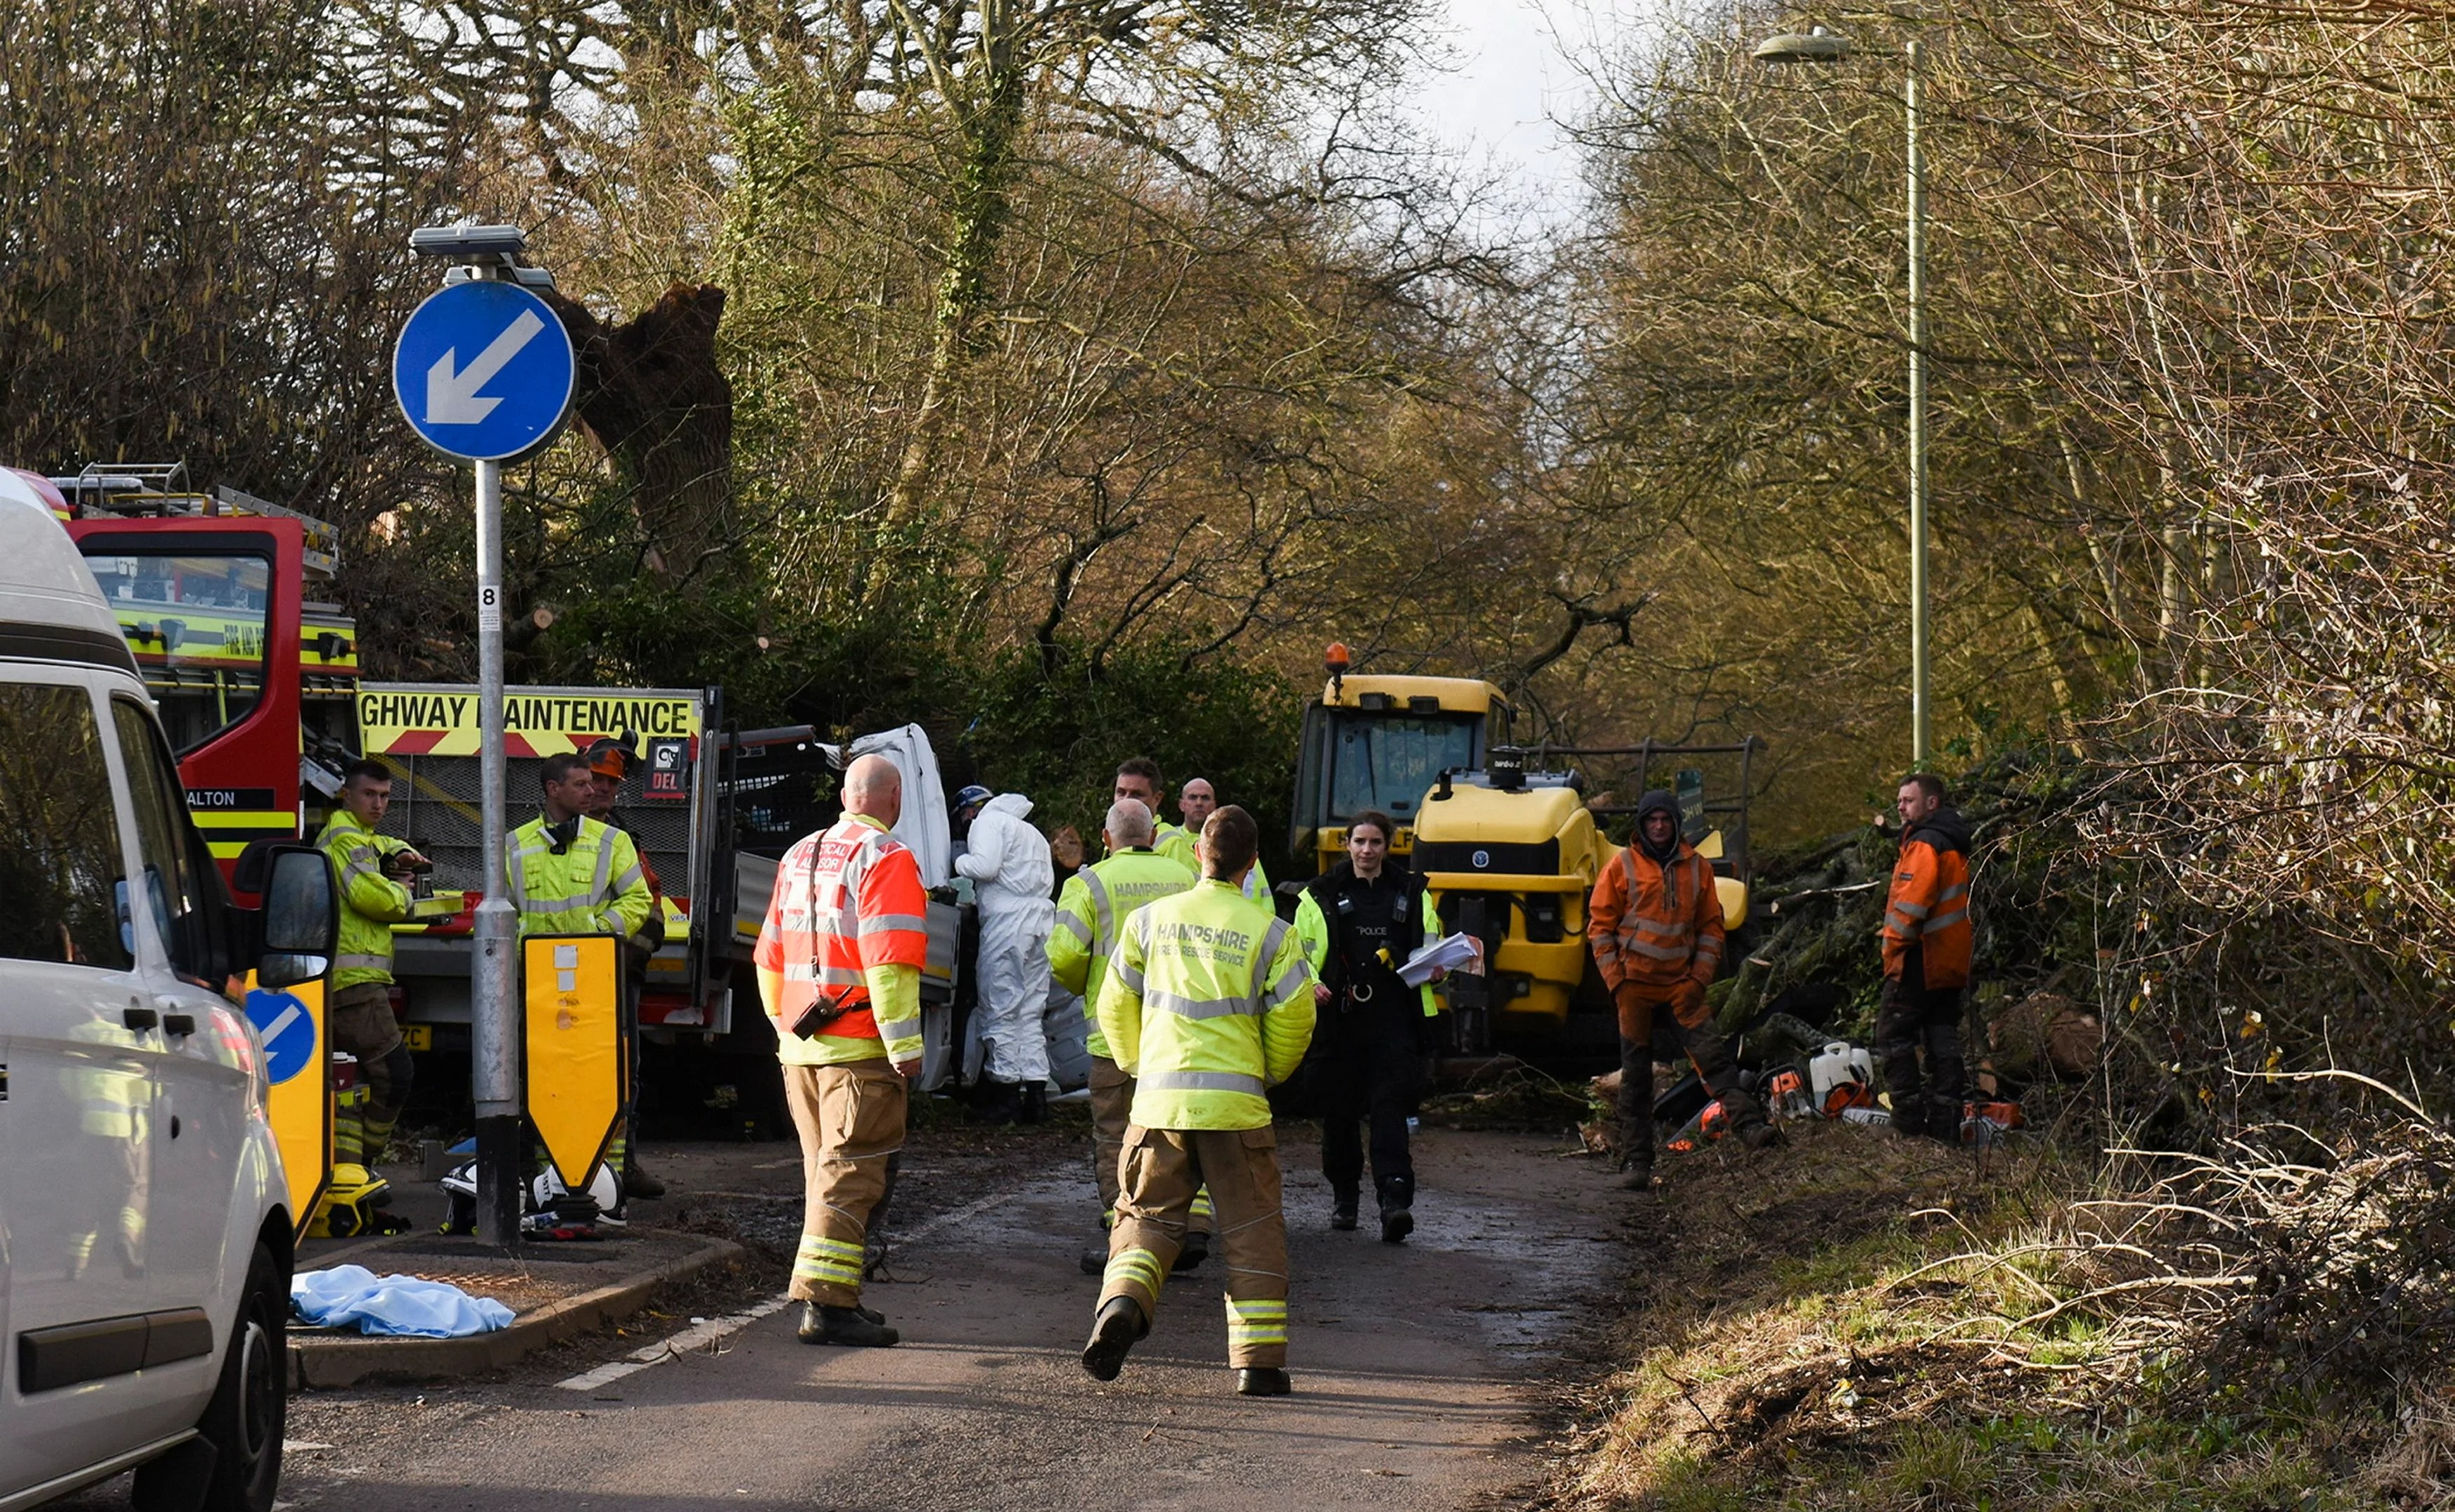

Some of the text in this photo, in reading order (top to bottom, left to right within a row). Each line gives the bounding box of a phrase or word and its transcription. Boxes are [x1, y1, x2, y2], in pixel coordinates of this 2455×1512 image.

[483, 588, 495, 606] 8
[476, 697, 688, 734] AINTENANCE
[652, 771, 678, 790] DEL
[187, 791, 235, 806] ALTON
[806, 842, 847, 856] TATICAL
[799, 856, 840, 870] ASOR
[1113, 882, 1188, 898] HAMPSHIRE
[1157, 922, 1250, 952] HAMPSHIRE
[1359, 925, 1387, 936] POLICE
[1181, 945, 1211, 959] RESCUE
[1212, 949, 1246, 968] SERVICE
